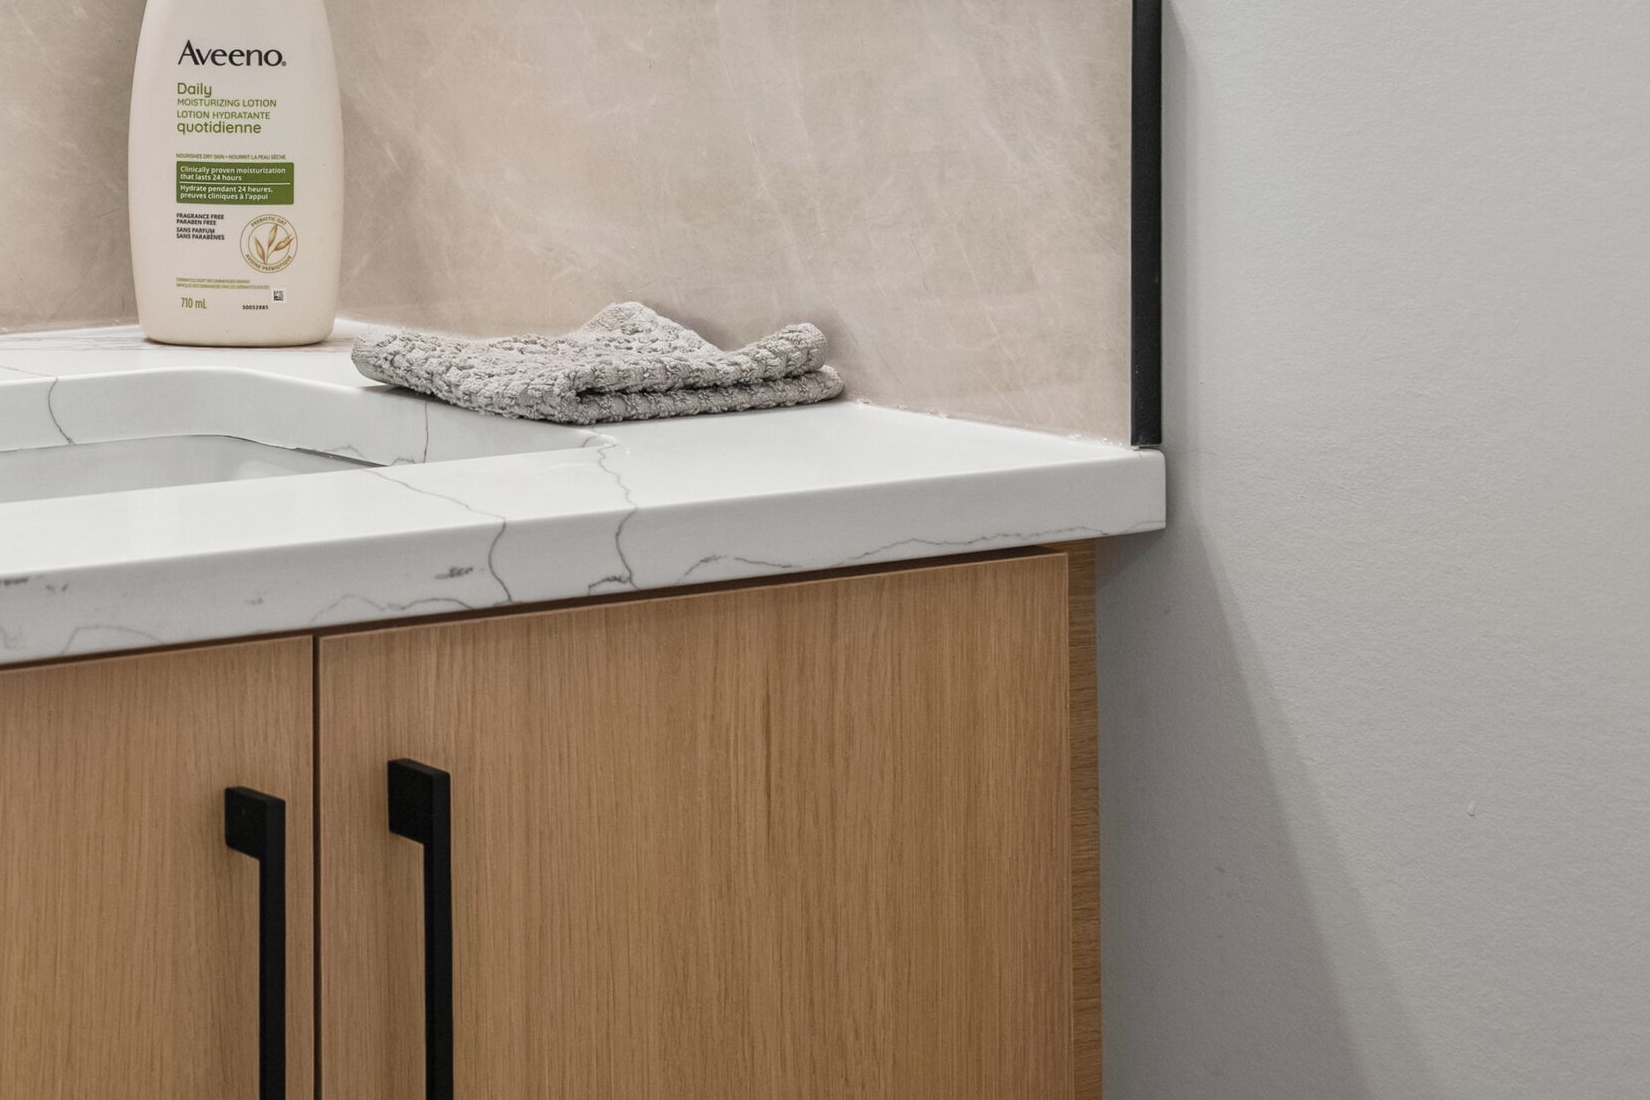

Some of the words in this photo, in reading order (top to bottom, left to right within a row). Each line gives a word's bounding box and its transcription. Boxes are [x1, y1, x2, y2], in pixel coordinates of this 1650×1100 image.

[177, 82, 212, 98] Daily
[177, 98, 240, 107] MOISTURIZING
[242, 99, 277, 108] LOTION
[177, 110, 210, 119] LOTION
[212, 111, 271, 120] HYDRATANTE
[177, 120, 262, 135] quotidienne
[180, 166, 210, 174] Clinically
[211, 167, 235, 175] proven
[180, 185, 207, 193] Hydrate
[207, 193, 238, 201] cliniques
[181, 297, 193, 309] 710
[194, 298, 207, 310] mL
